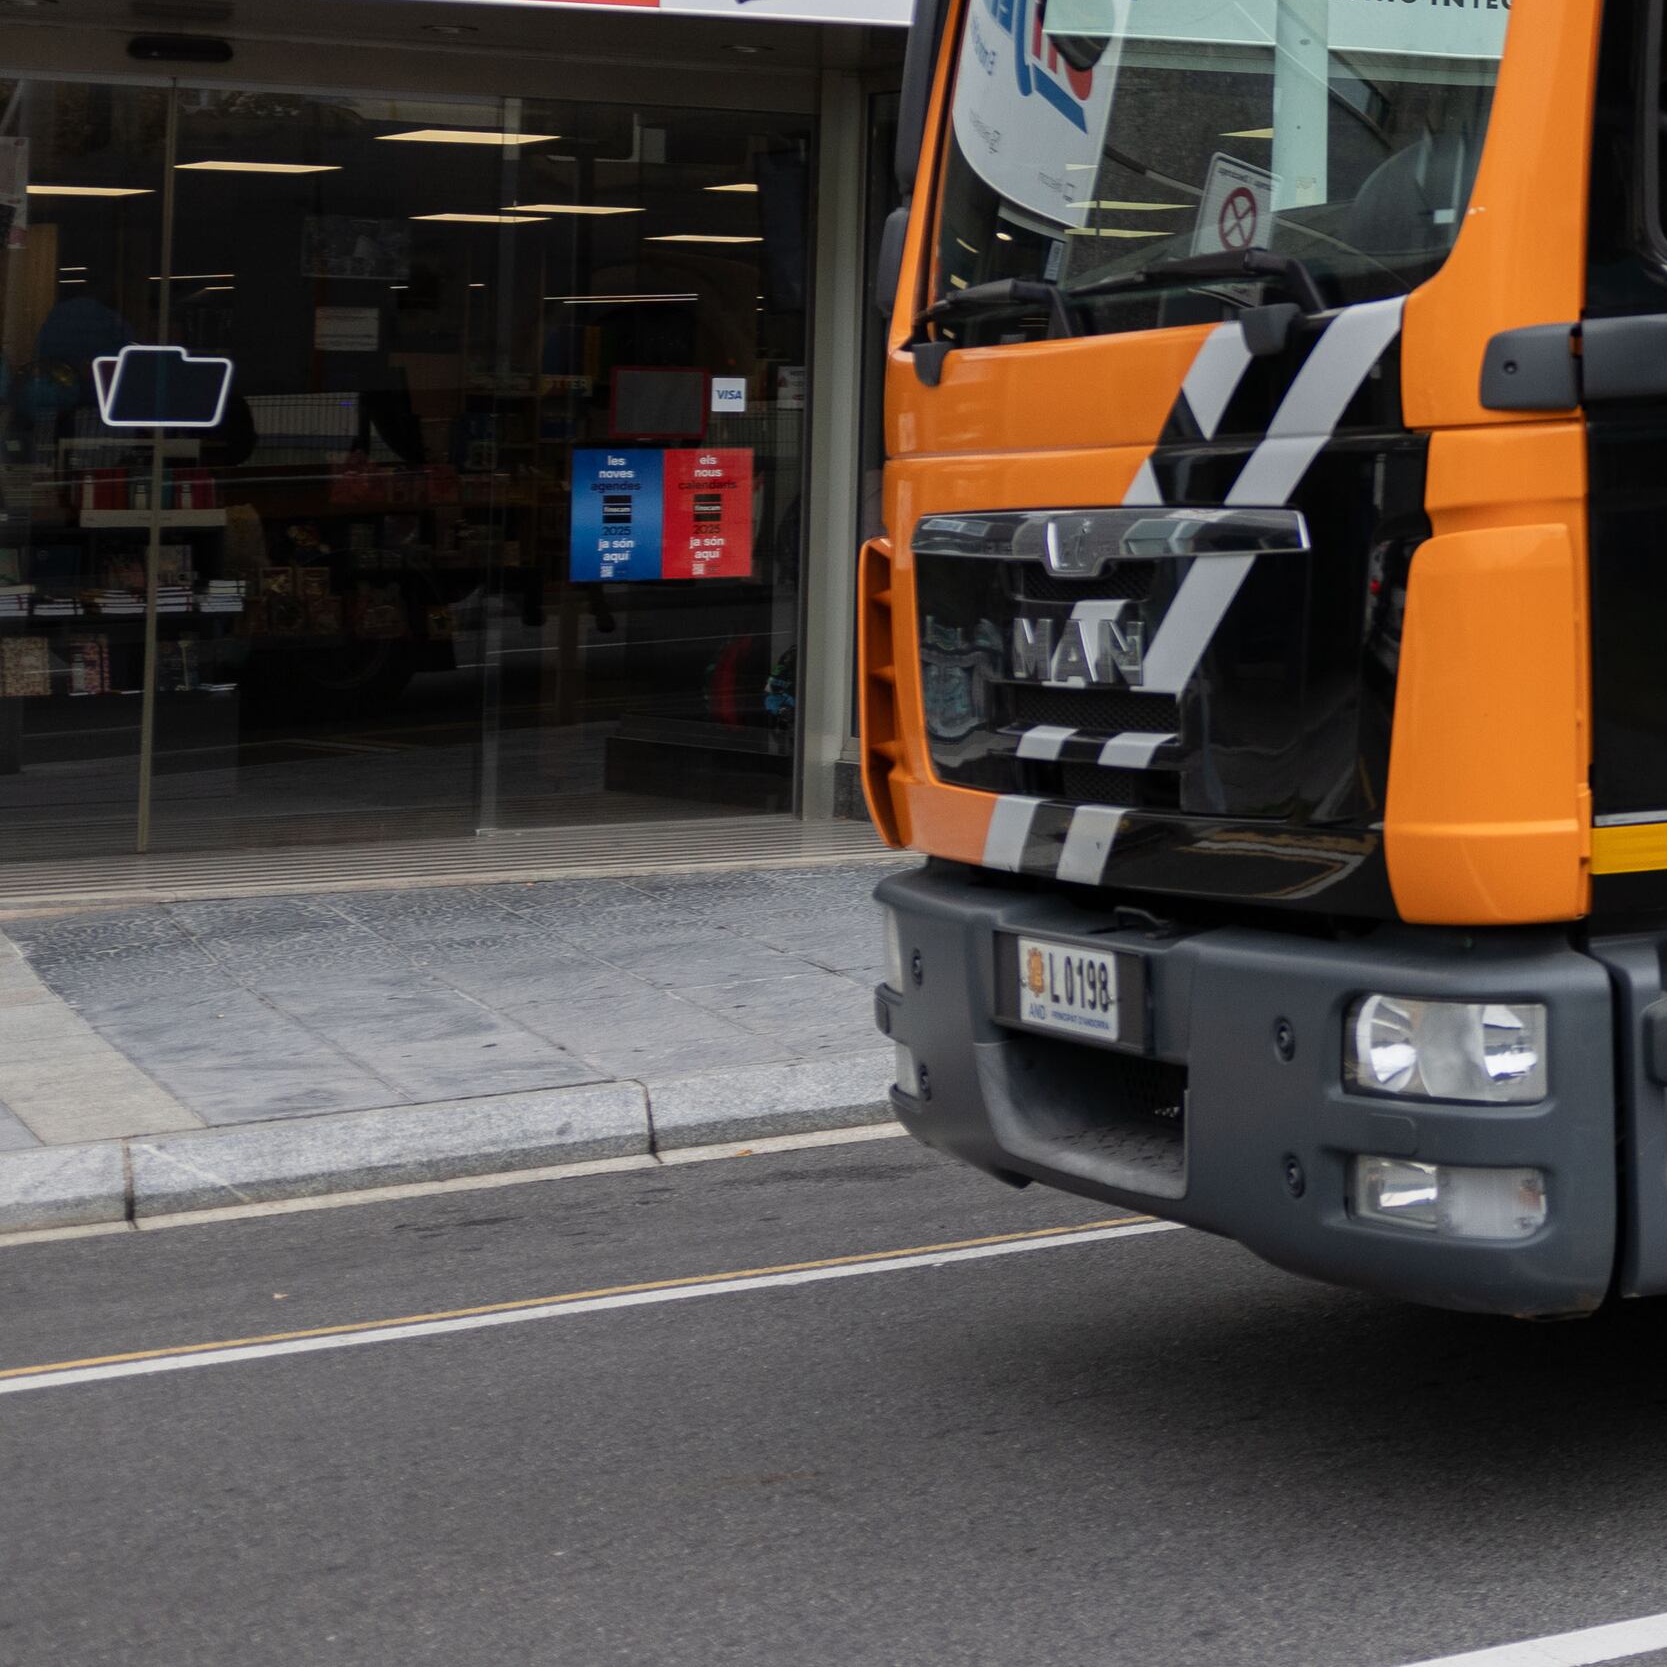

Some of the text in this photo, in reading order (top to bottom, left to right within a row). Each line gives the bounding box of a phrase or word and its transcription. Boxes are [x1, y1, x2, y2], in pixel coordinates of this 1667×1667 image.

[716, 389, 743, 400] VISA
[607, 455, 627, 466] les
[699, 454, 718, 465] els
[598, 469, 635, 479] noves
[694, 468, 723, 478] nous
[591, 482, 641, 493] agendes
[602, 526, 632, 536] 2025
[693, 524, 721, 534] 2025
[598, 537, 635, 551] ja són
[689, 536, 725, 549] ja són
[1012, 617, 1145, 686] MAN
[1048, 952, 1110, 1013] L0198
